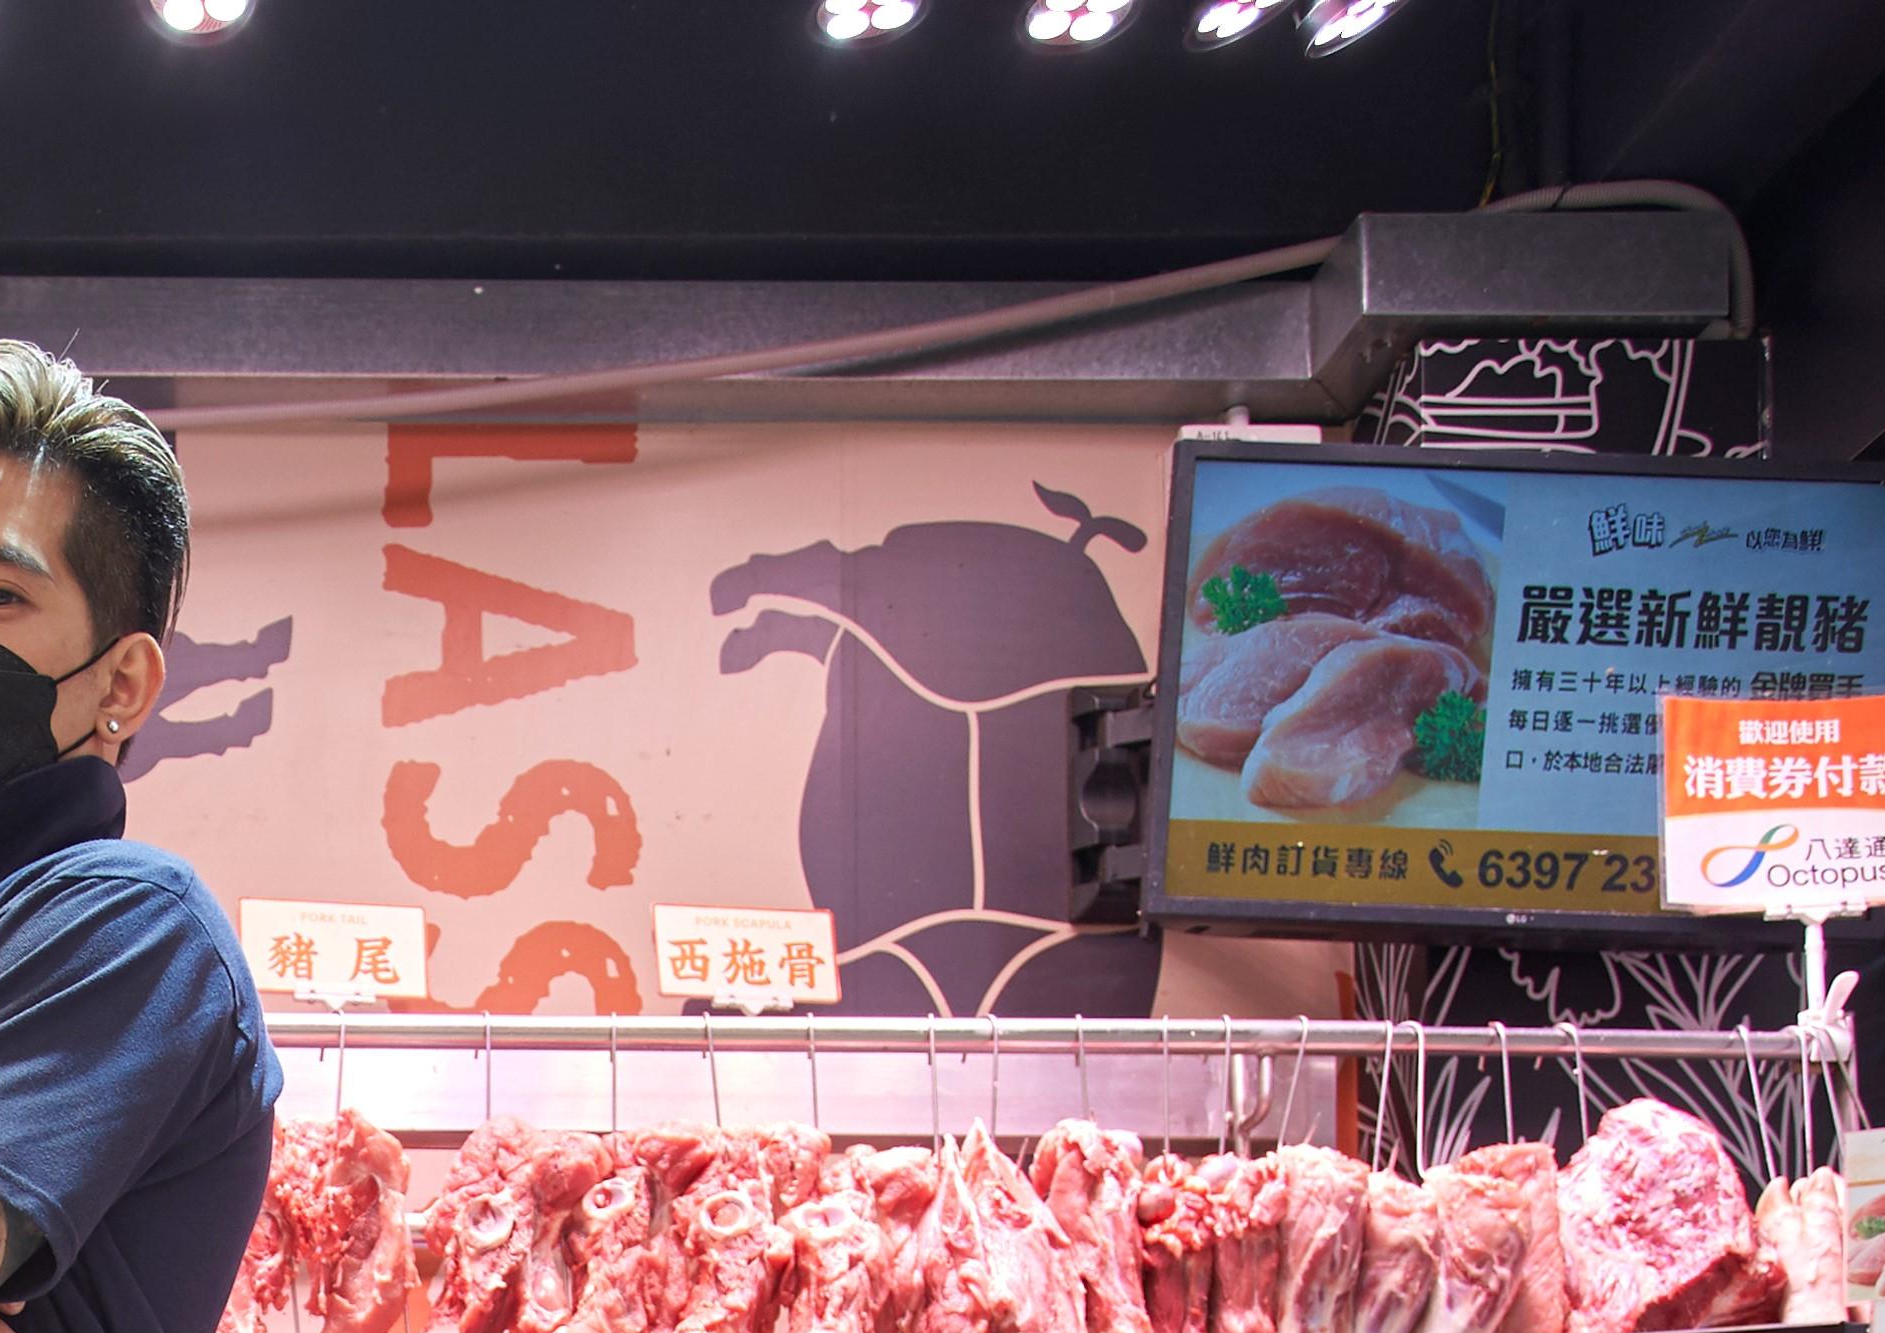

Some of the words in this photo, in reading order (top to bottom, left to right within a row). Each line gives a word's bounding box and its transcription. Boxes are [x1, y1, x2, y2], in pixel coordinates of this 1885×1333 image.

[1588, 502, 1665, 556] 鮮味
[1516, 584, 1871, 654] 嚴選新鮮靚豬
[1739, 719, 1841, 746] 歡迎使用
[1206, 842, 1410, 880] 鮮肉訂貨專線
[1477, 848, 1590, 891] 6397
[1767, 863, 1885, 888] Octopus
[299, 911, 336, 924] PORK
[340, 913, 369, 926] TAIL
[695, 916, 729, 928] PORK
[733, 917, 793, 931] SCAPULA
[268, 931, 401, 985] 豬尾
[667, 937, 826, 990] 西施骨
